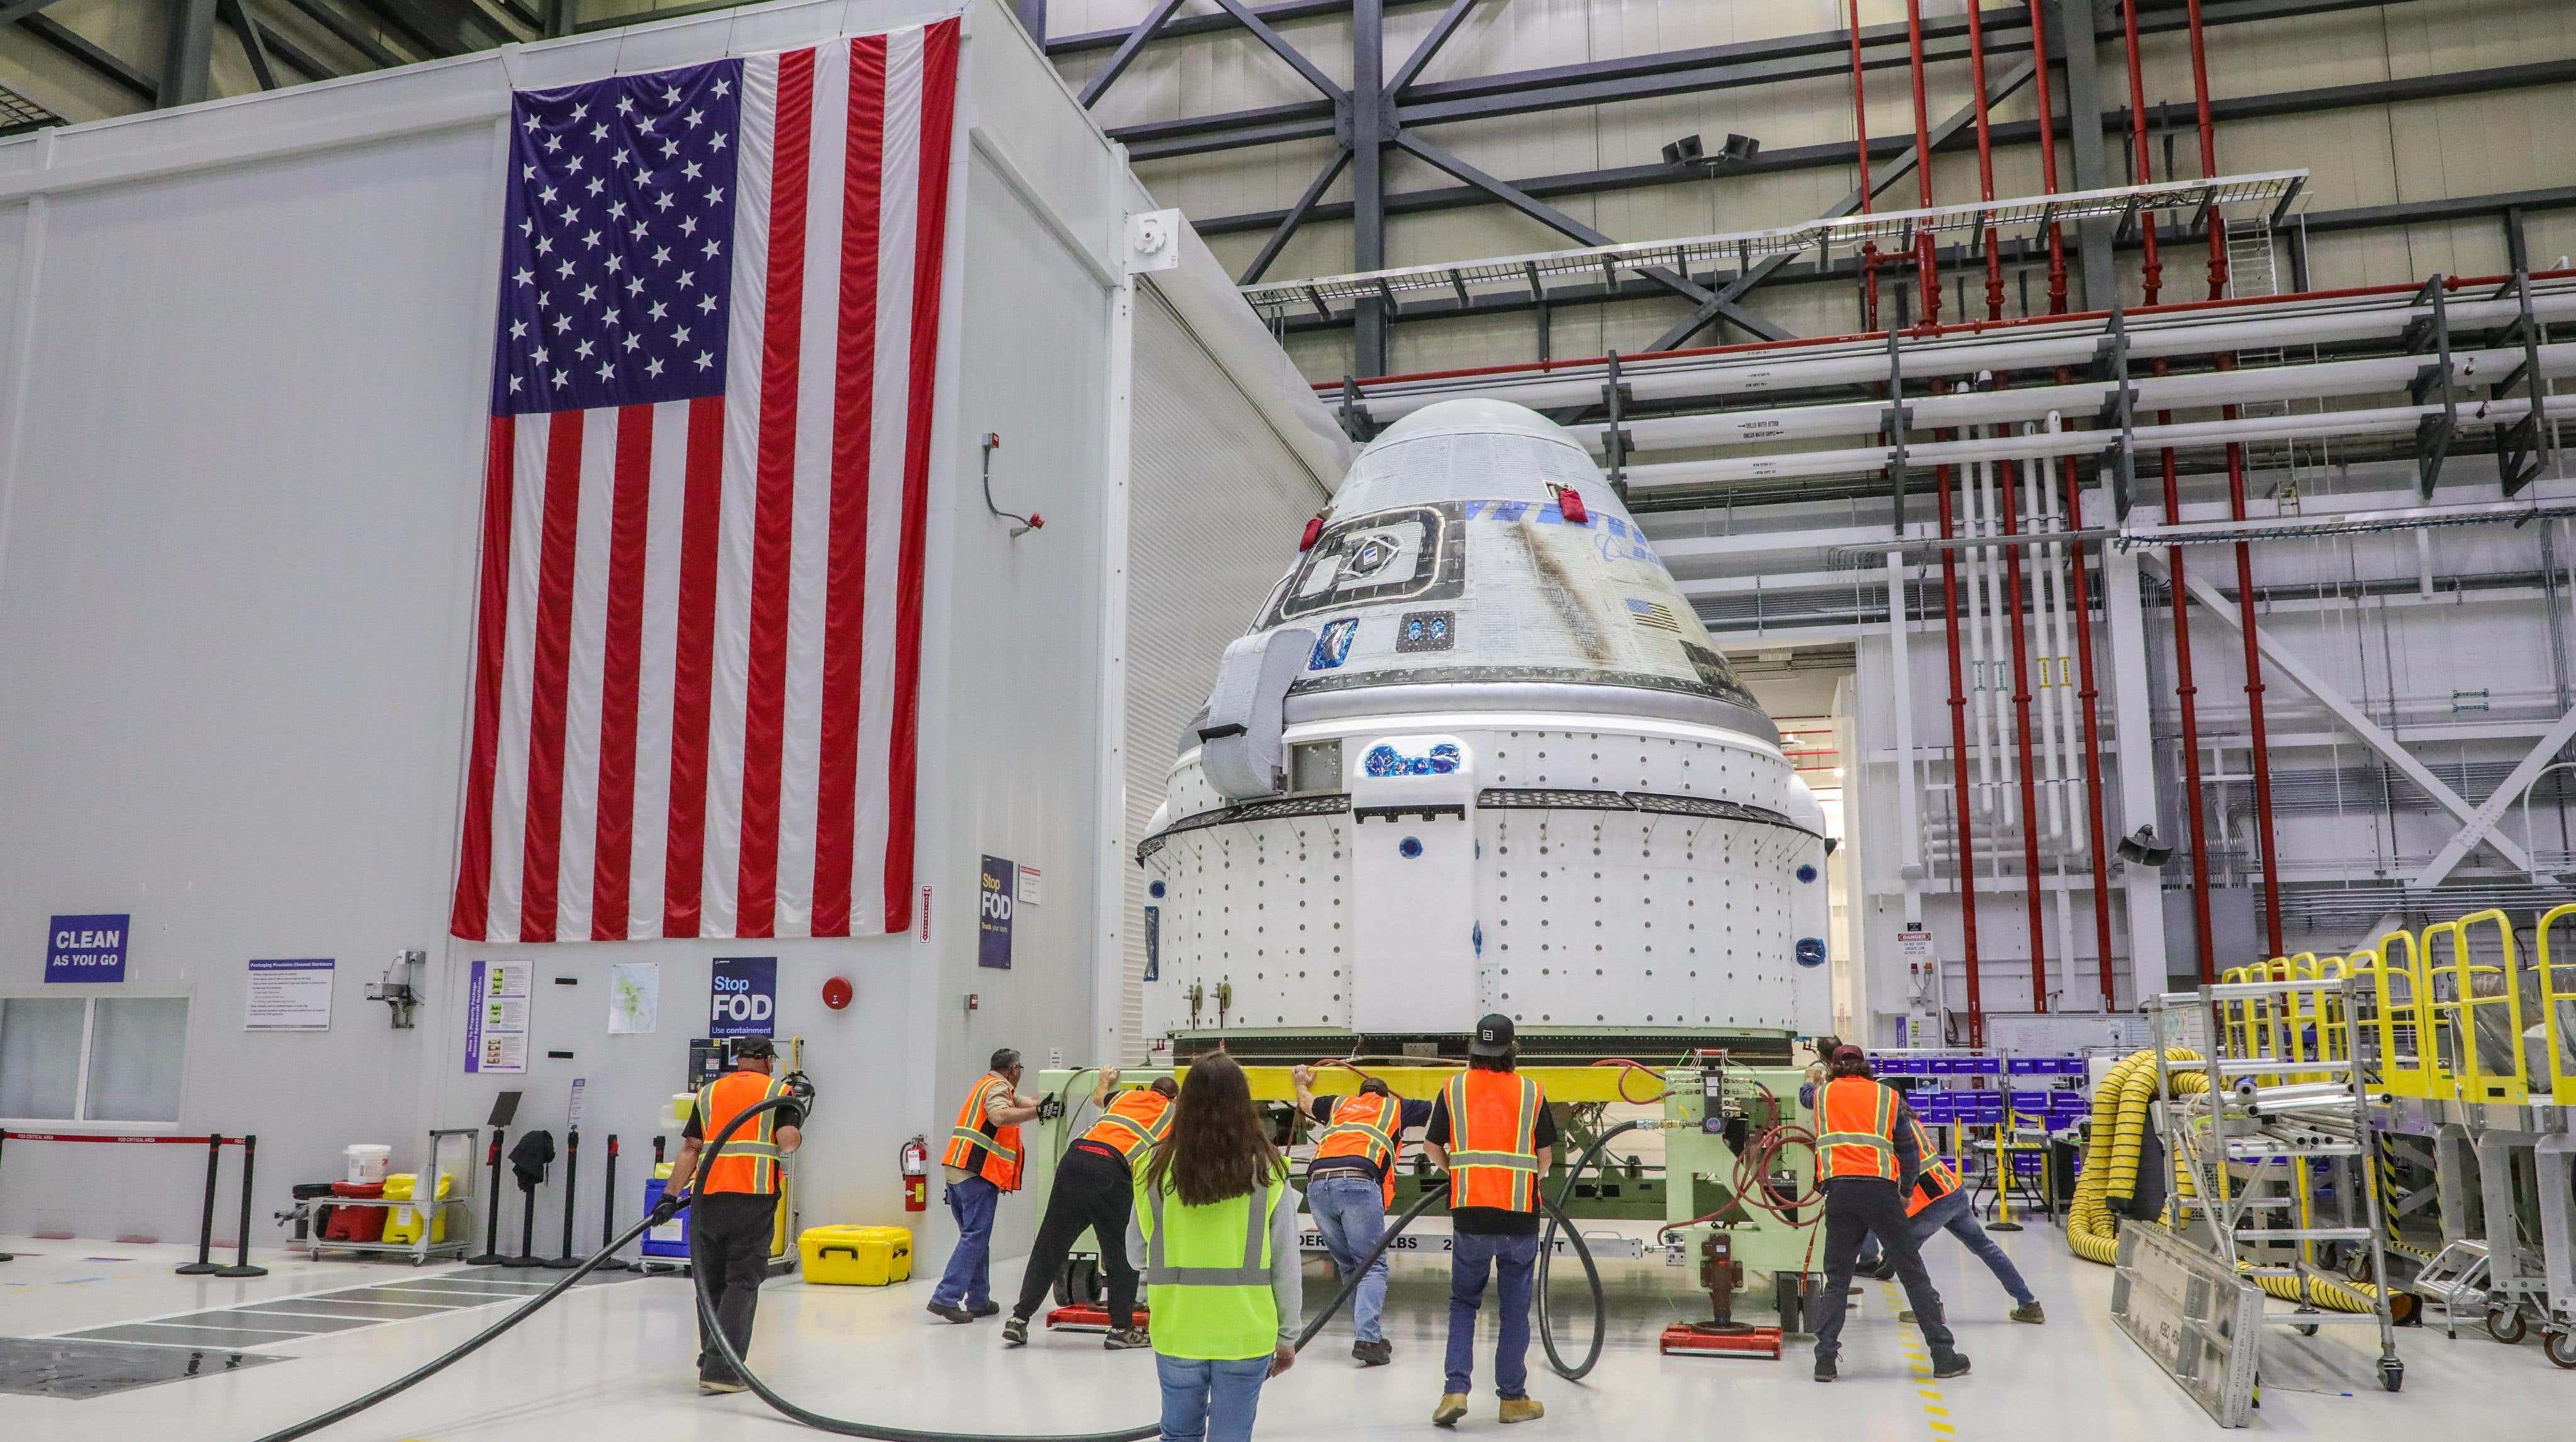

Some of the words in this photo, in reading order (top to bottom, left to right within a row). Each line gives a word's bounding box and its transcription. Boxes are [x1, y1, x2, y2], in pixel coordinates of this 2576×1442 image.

[983, 873, 1000, 892] Stop
[981, 891, 1012, 920] FOD
[981, 922, 992, 931] Track
[56, 931, 120, 949] CLEAN
[53, 955, 69, 966] AS
[72, 954, 97, 966] YOU
[100, 954, 118, 965] GO
[715, 976, 749, 993] Stop
[712, 994, 772, 1021] FOD
[726, 1026, 772, 1034] containment
